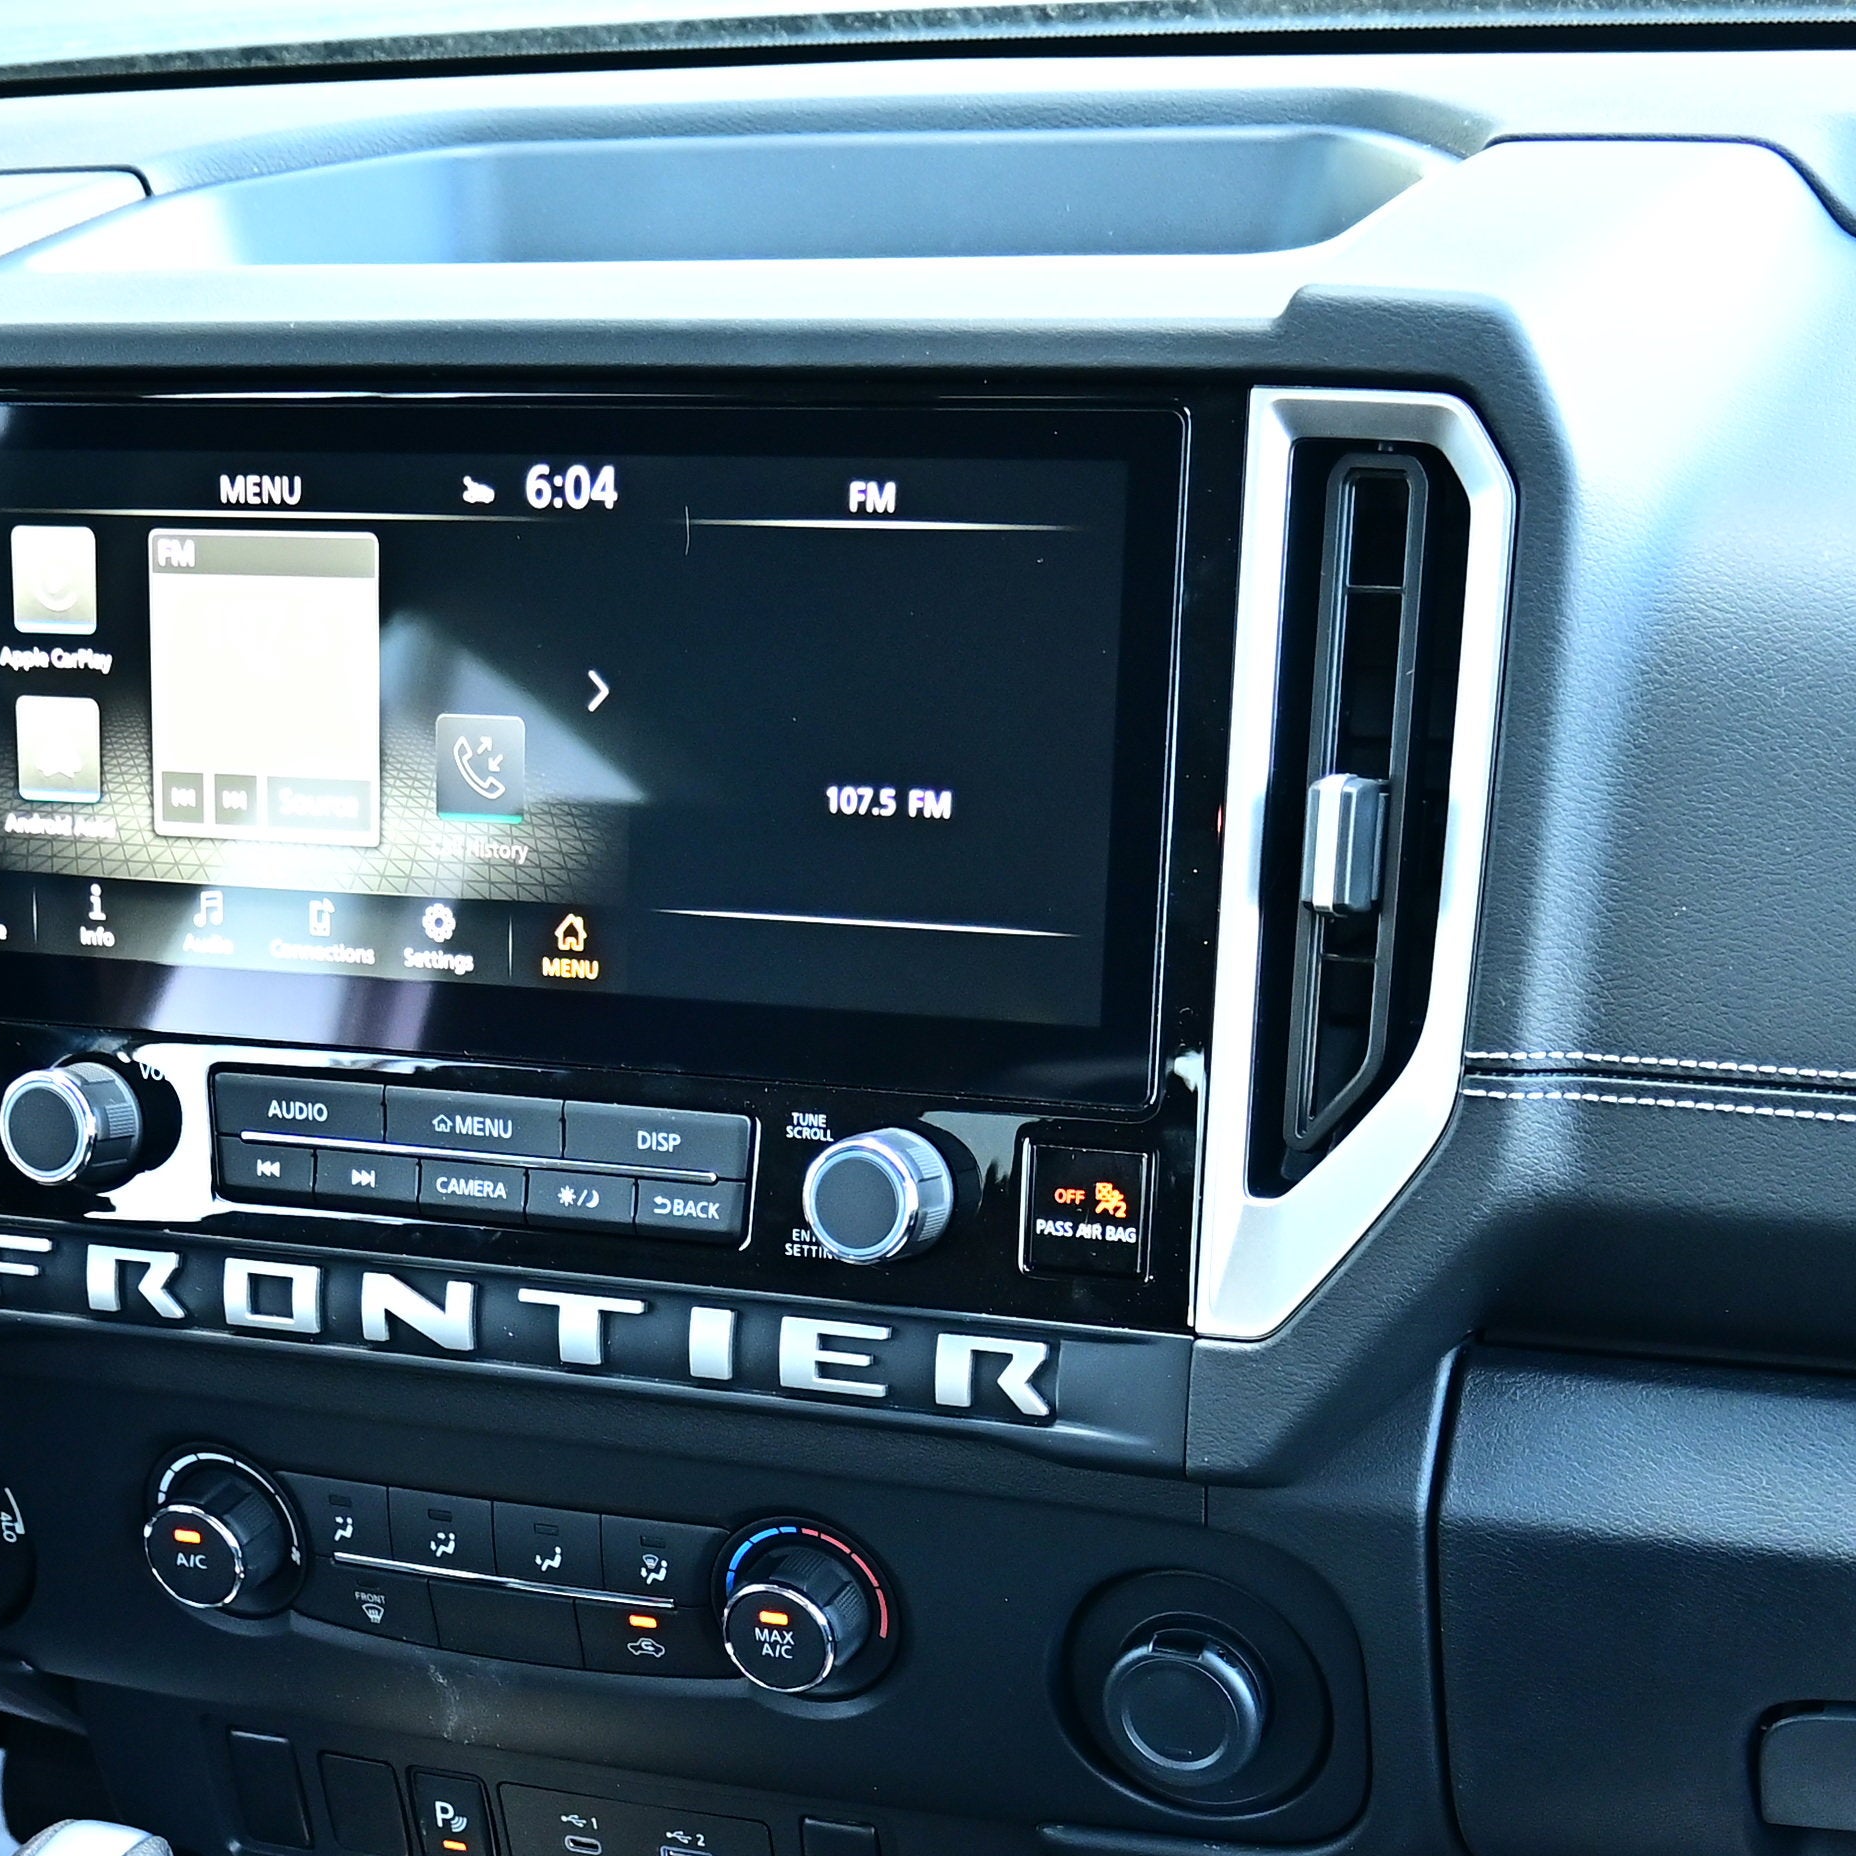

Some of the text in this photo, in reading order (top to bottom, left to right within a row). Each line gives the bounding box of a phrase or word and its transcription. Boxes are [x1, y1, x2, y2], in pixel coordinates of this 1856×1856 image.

[218, 474, 303, 506] MENU
[525, 464, 618, 511] 6:04
[849, 480, 897, 513] FM
[157, 540, 196, 569] FM
[50, 648, 112, 676] CarPlay
[825, 786, 952, 820] 107.5 FM
[4, 812, 71, 838] Android
[470, 840, 529, 865] History
[80, 925, 115, 949] Info
[183, 933, 234, 956] Audio
[269, 938, 376, 968] Connections
[403, 947, 475, 975] Settings
[542, 956, 599, 980] MENU
[268, 1100, 328, 1123] AUDIO
[791, 1112, 827, 1128] TUNE
[455, 1115, 513, 1140] MENU
[785, 1126, 834, 1143] SCROLL
[636, 1130, 682, 1152] DISP
[436, 1176, 507, 1200] CAMERA
[1054, 1188, 1085, 1205] OFF
[673, 1199, 720, 1221] BACK
[1036, 1219, 1137, 1243] PASS AIR BAG
[0, 1511, 17, 1543] 4LO
[176, 1552, 208, 1571] A/C
[355, 1591, 386, 1606] FRONT
[755, 1628, 795, 1647] MAX
[761, 1642, 794, 1660] A/C
